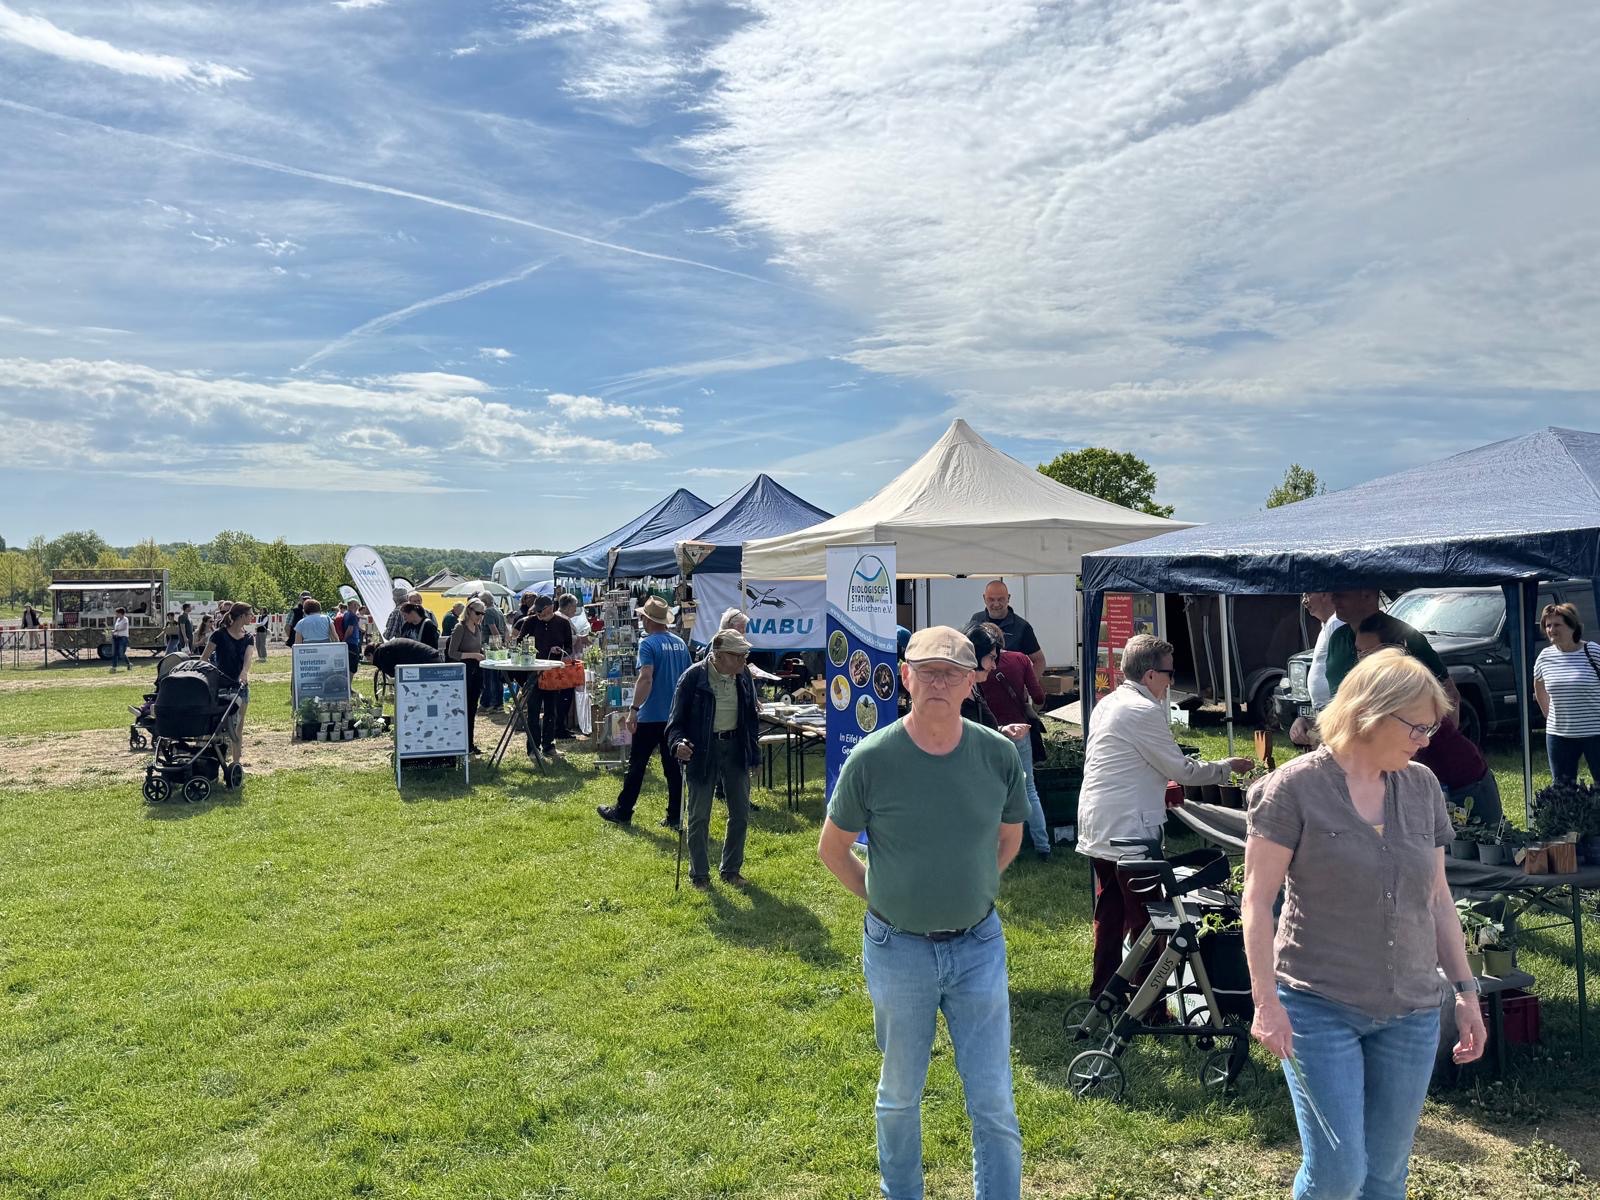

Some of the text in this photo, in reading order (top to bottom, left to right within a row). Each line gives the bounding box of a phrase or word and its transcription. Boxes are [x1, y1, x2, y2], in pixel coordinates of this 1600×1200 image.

[851, 585, 889, 595] BIOLOGISCHE
[851, 594, 875, 603] STATION
[851, 603, 893, 614] Euskirchen e.V.
[745, 618, 814, 635] NABU
[661, 643, 685, 651] NABU
[839, 732, 845, 741] In
[845, 733, 858, 744] Eifel
[1150, 958, 1174, 990] STYLUS
